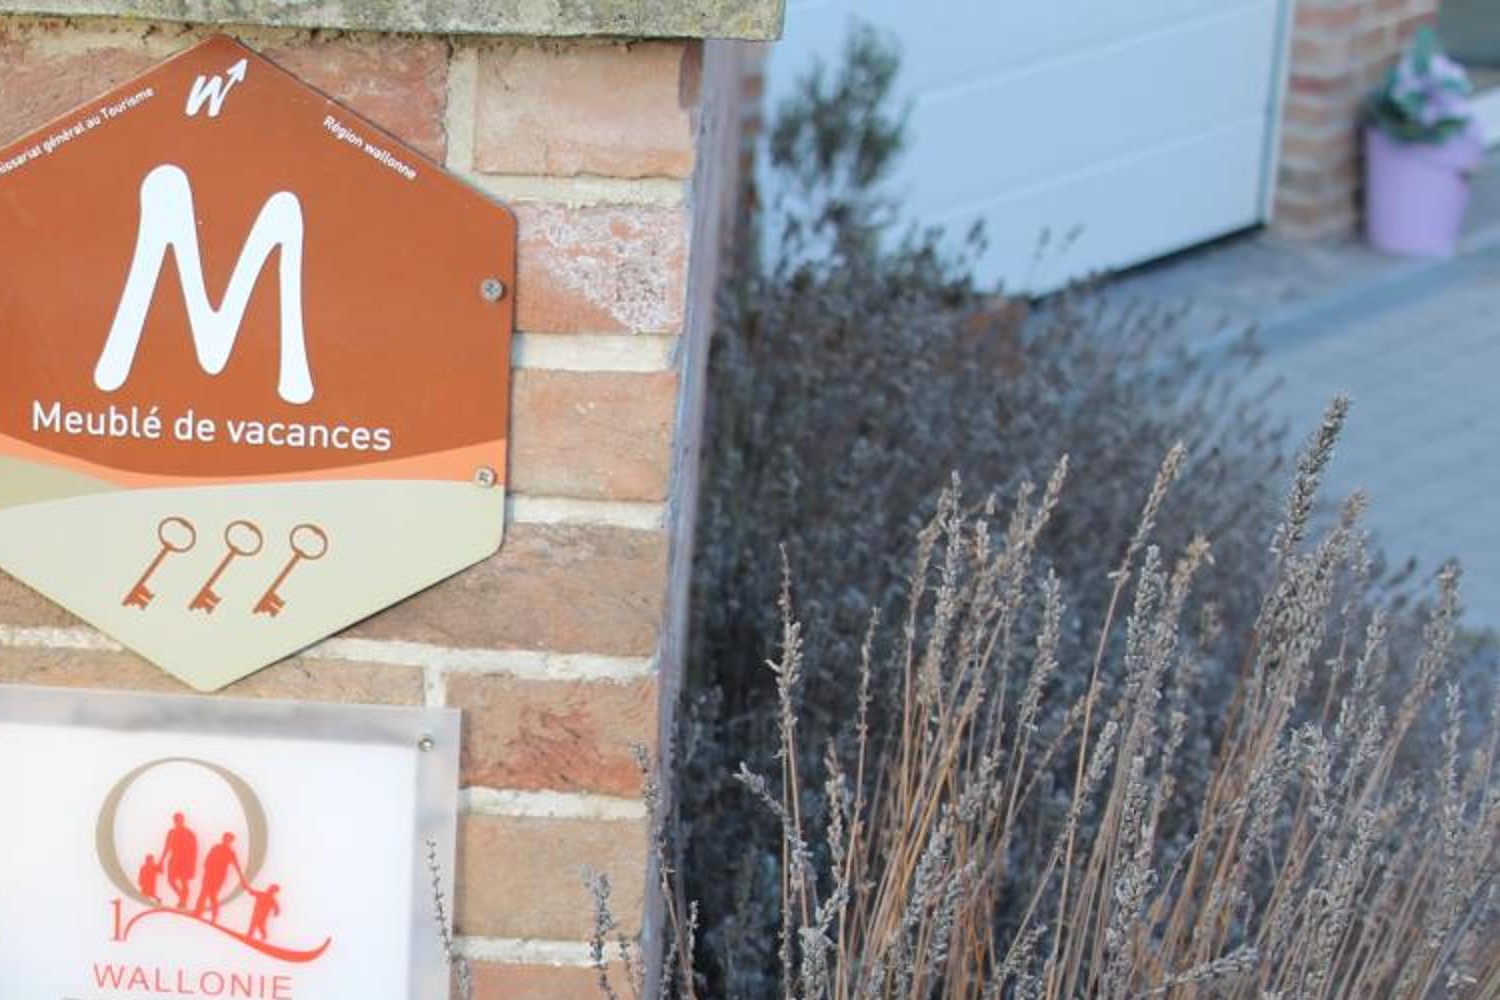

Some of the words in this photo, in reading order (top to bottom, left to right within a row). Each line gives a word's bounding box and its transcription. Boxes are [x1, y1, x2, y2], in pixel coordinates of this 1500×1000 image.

[43, 122, 84, 152] général
[86, 116, 101, 129] au
[100, 87, 155, 119] Tourisme
[324, 115, 363, 148] Région
[364, 143, 417, 180] wallonne
[94, 164, 314, 404] M
[32, 400, 161, 439] Meublé
[173, 409, 216, 442] de
[227, 420, 392, 452] vacances
[94, 962, 293, 1000] WALLONIE
